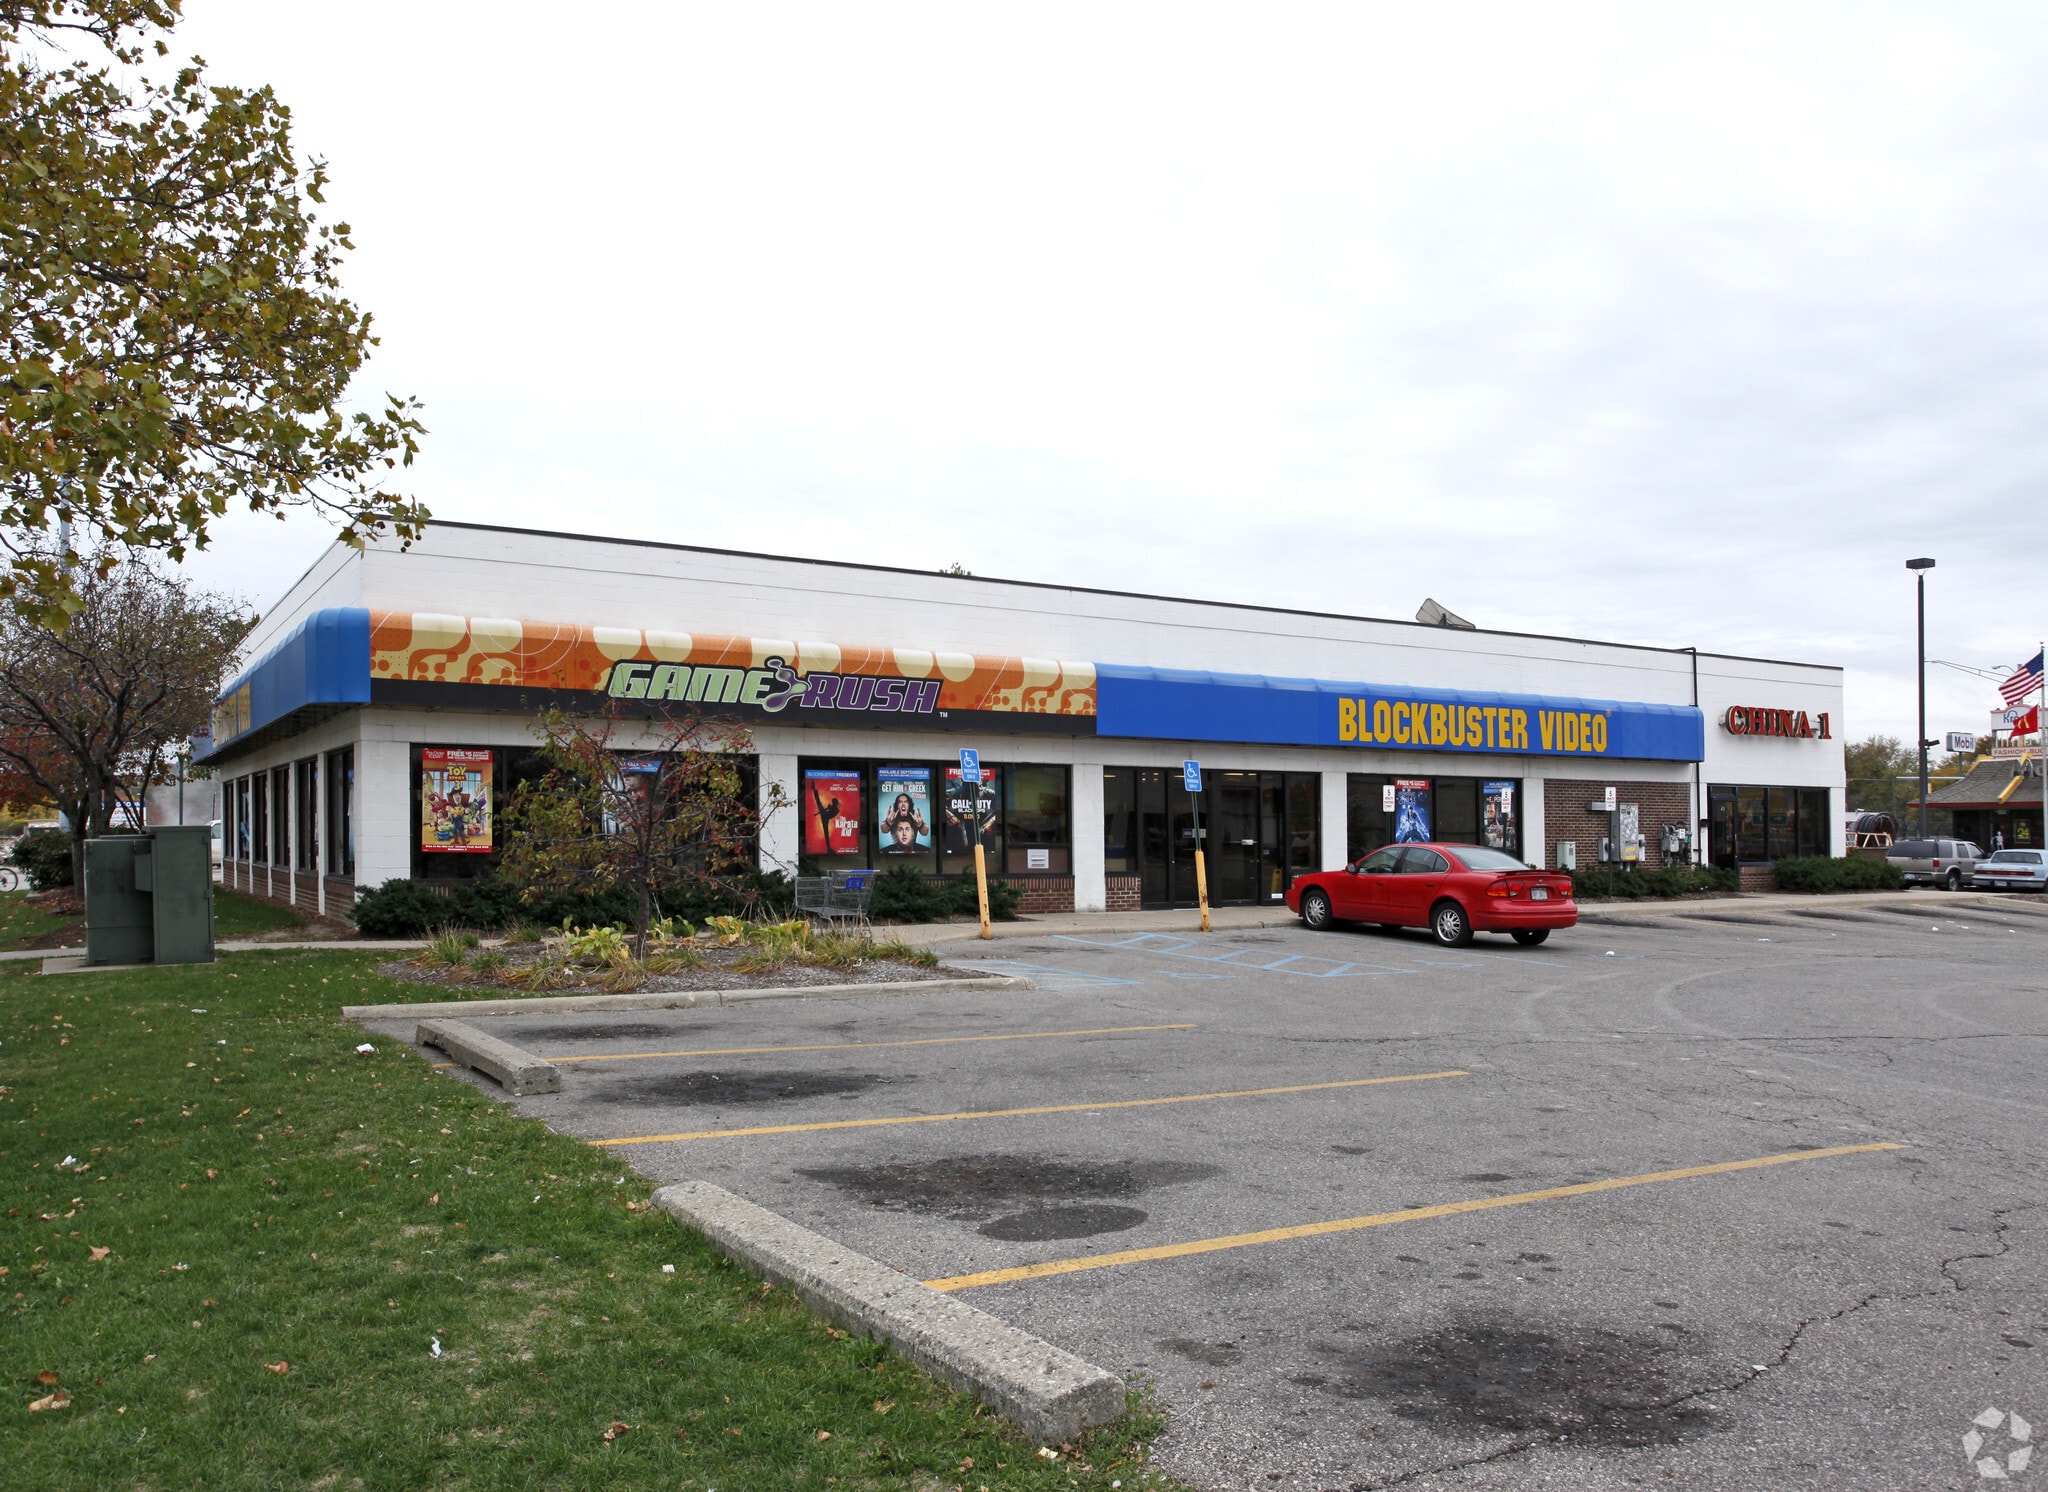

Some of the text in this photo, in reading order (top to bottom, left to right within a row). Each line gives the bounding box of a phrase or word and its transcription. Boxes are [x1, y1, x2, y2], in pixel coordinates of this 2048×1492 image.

[608, 662, 941, 713] GAME RUSH
[1338, 697, 1608, 753] BLOCKBUSTER VIDEO
[1725, 705, 1832, 739] CHINA 1
[1954, 736, 1974, 749] Mobil
[447, 766, 467, 776] TOY
[454, 780, 460, 790] 3
[882, 784, 892, 792] GET
[893, 784, 904, 792] HIM
[908, 785, 926, 793] GREEK
[951, 799, 992, 810] CALL UTY
[835, 819, 858, 828] Karate
[841, 828, 852, 837] Kid
[2017, 828, 2030, 837] 24
